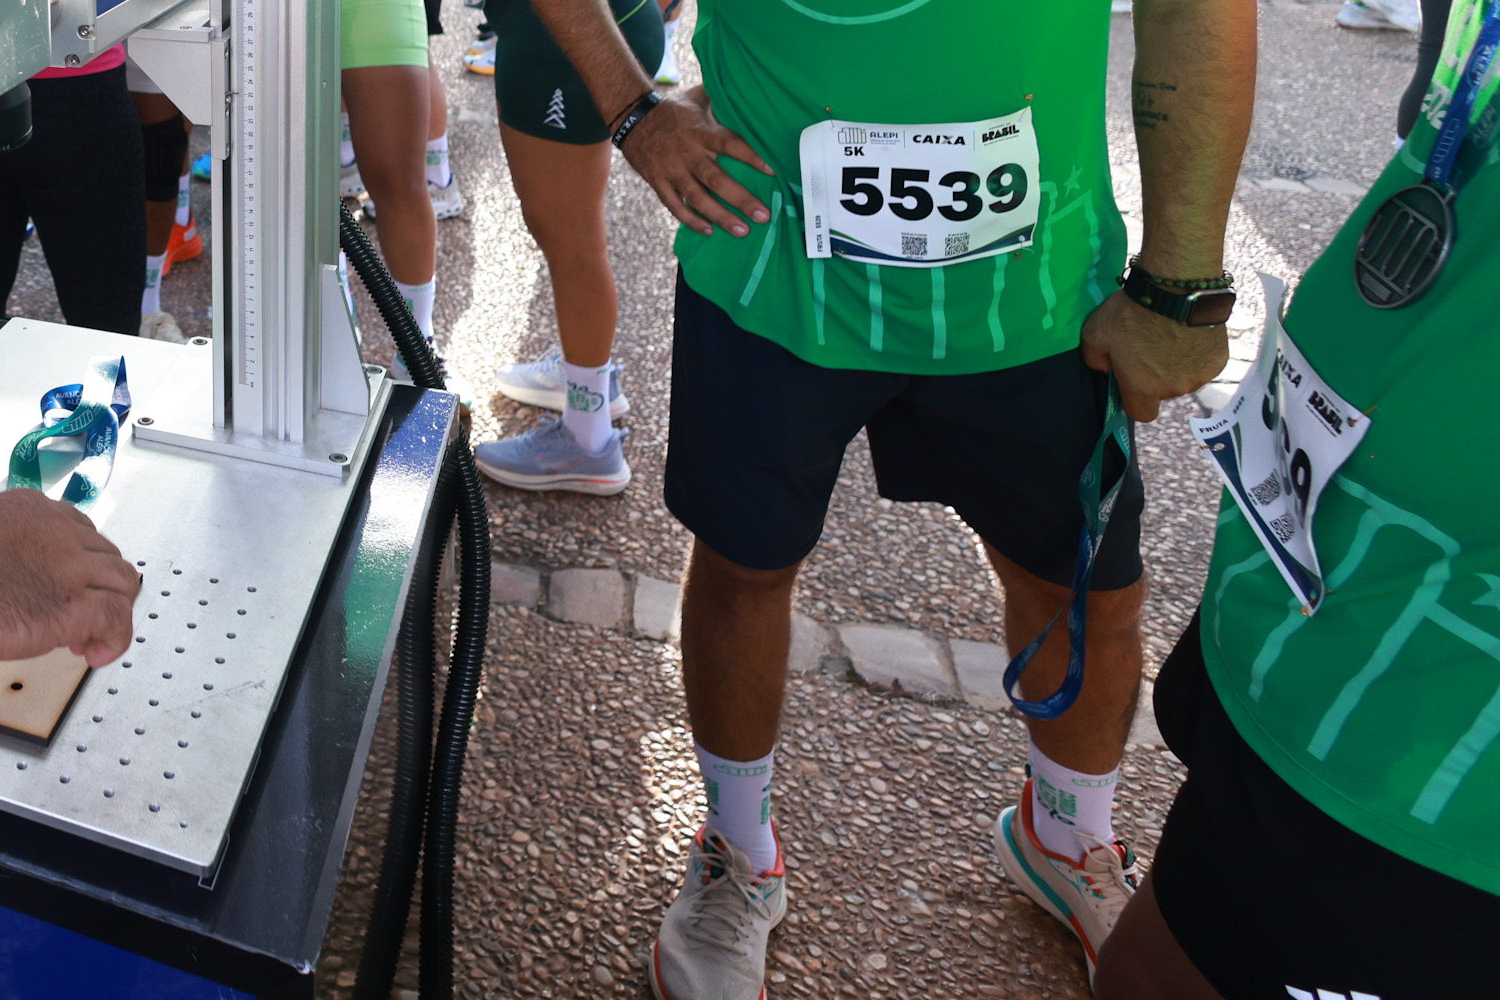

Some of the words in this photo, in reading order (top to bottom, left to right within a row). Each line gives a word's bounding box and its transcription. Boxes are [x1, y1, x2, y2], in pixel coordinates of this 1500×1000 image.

[869, 131, 899, 140] ALEPI
[912, 134, 966, 146] CAIXA
[982, 123, 1020, 144] BRASIL
[844, 146, 865, 157] 5K
[839, 162, 1029, 222] 5539
[67, 398, 81, 406] ALE
[1198, 419, 1230, 434] FRUTA
